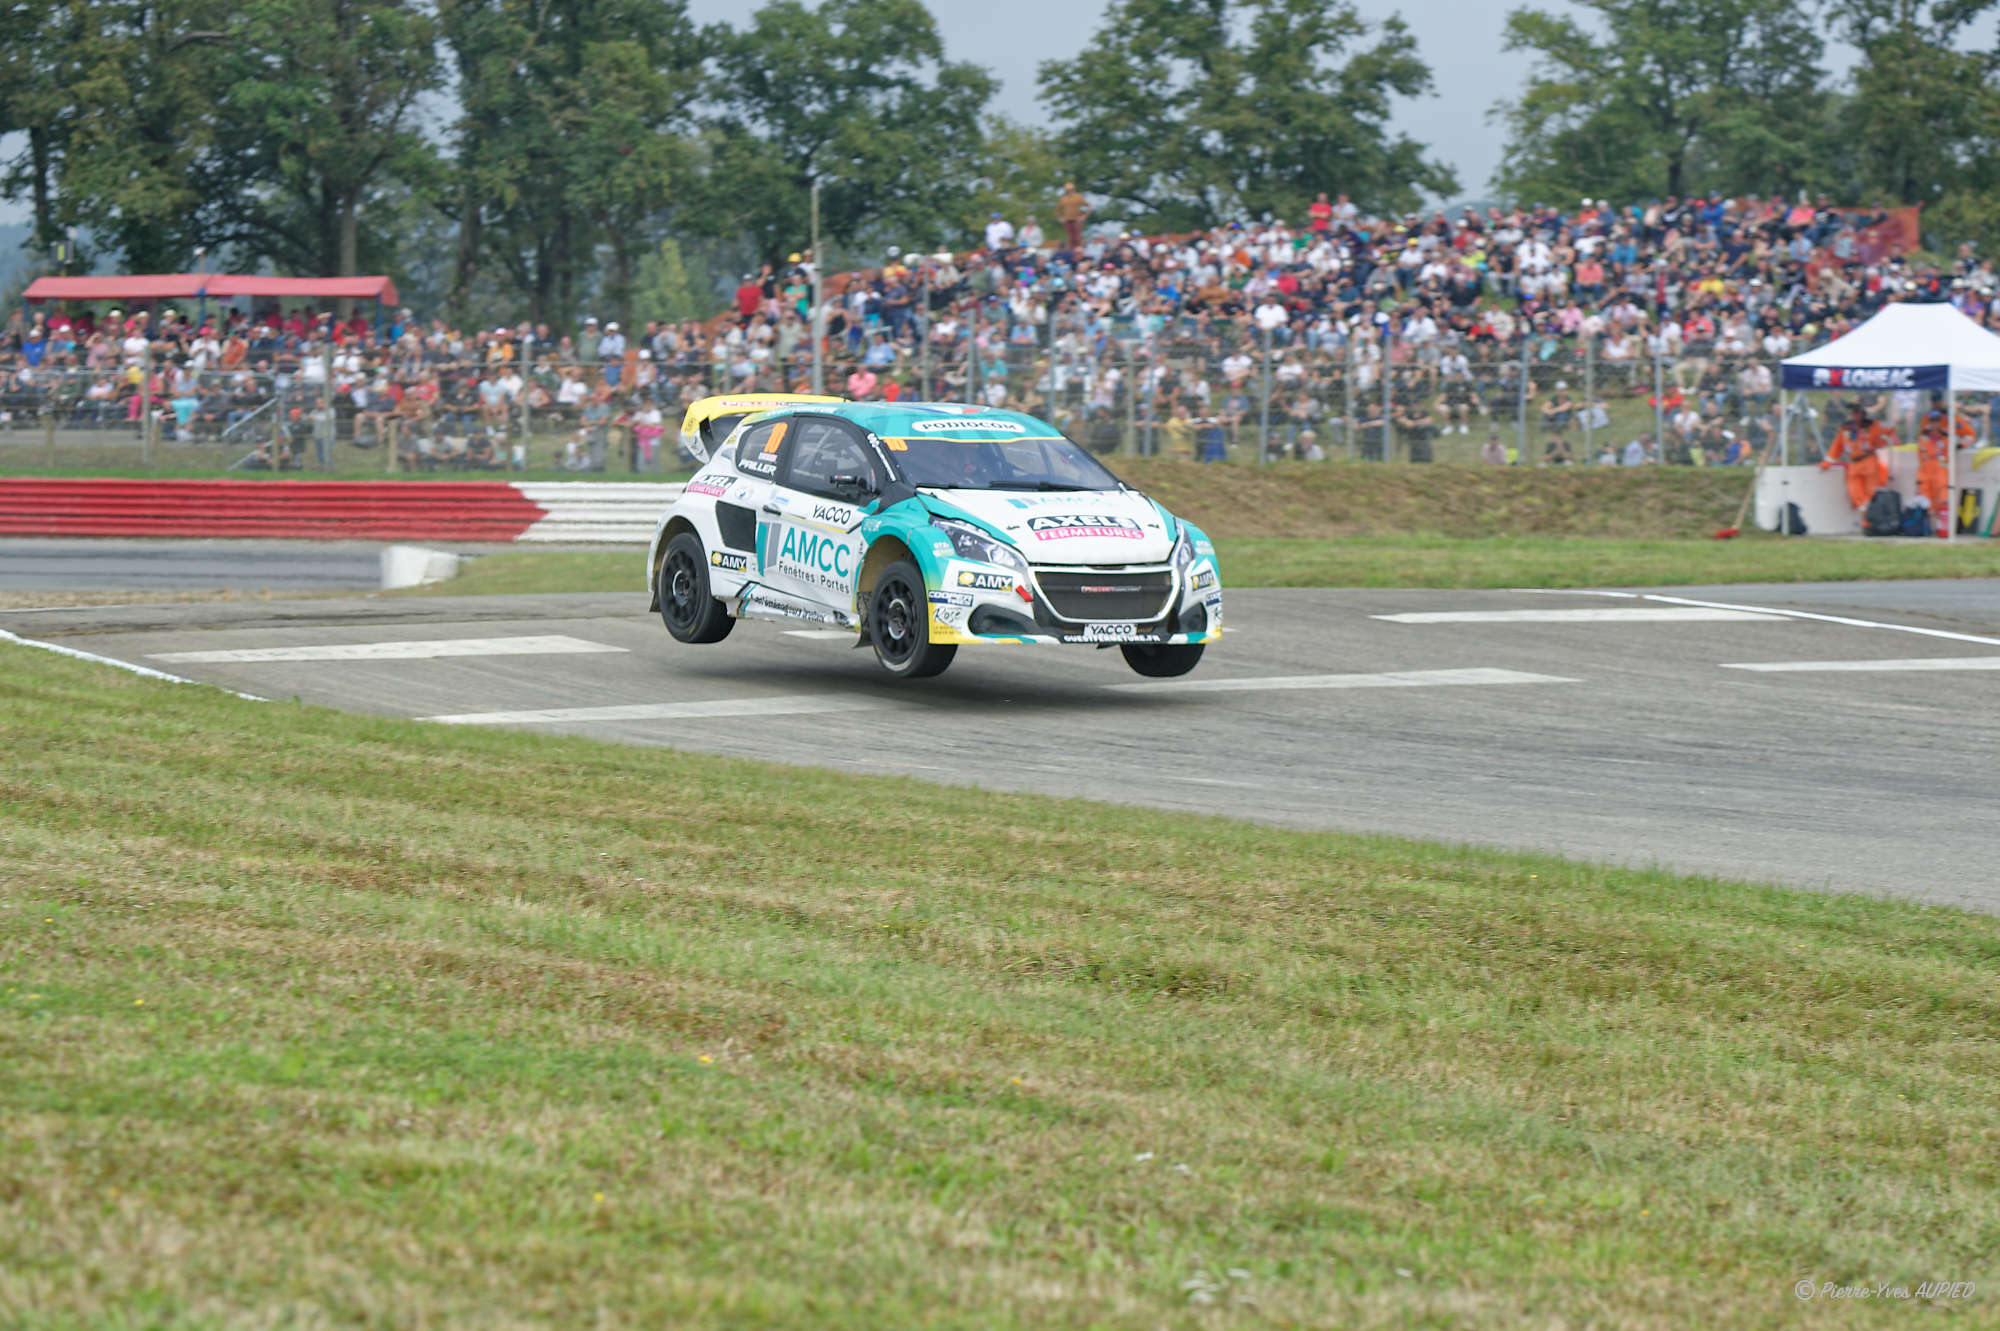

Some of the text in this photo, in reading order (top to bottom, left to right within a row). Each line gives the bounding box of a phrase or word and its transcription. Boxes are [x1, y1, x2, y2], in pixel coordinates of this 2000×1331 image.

[922, 421, 1017, 431] PODIOCOM
[764, 422, 788, 454] 10
[813, 504, 851, 525] YACCO
[1039, 527, 1144, 540] FERMETURES
[781, 527, 851, 578] AMCC
[722, 556, 747, 569] AMY
[820, 575, 850, 594] Portes
[975, 574, 1012, 588] AMY
[1091, 625, 1132, 635] YACCO
